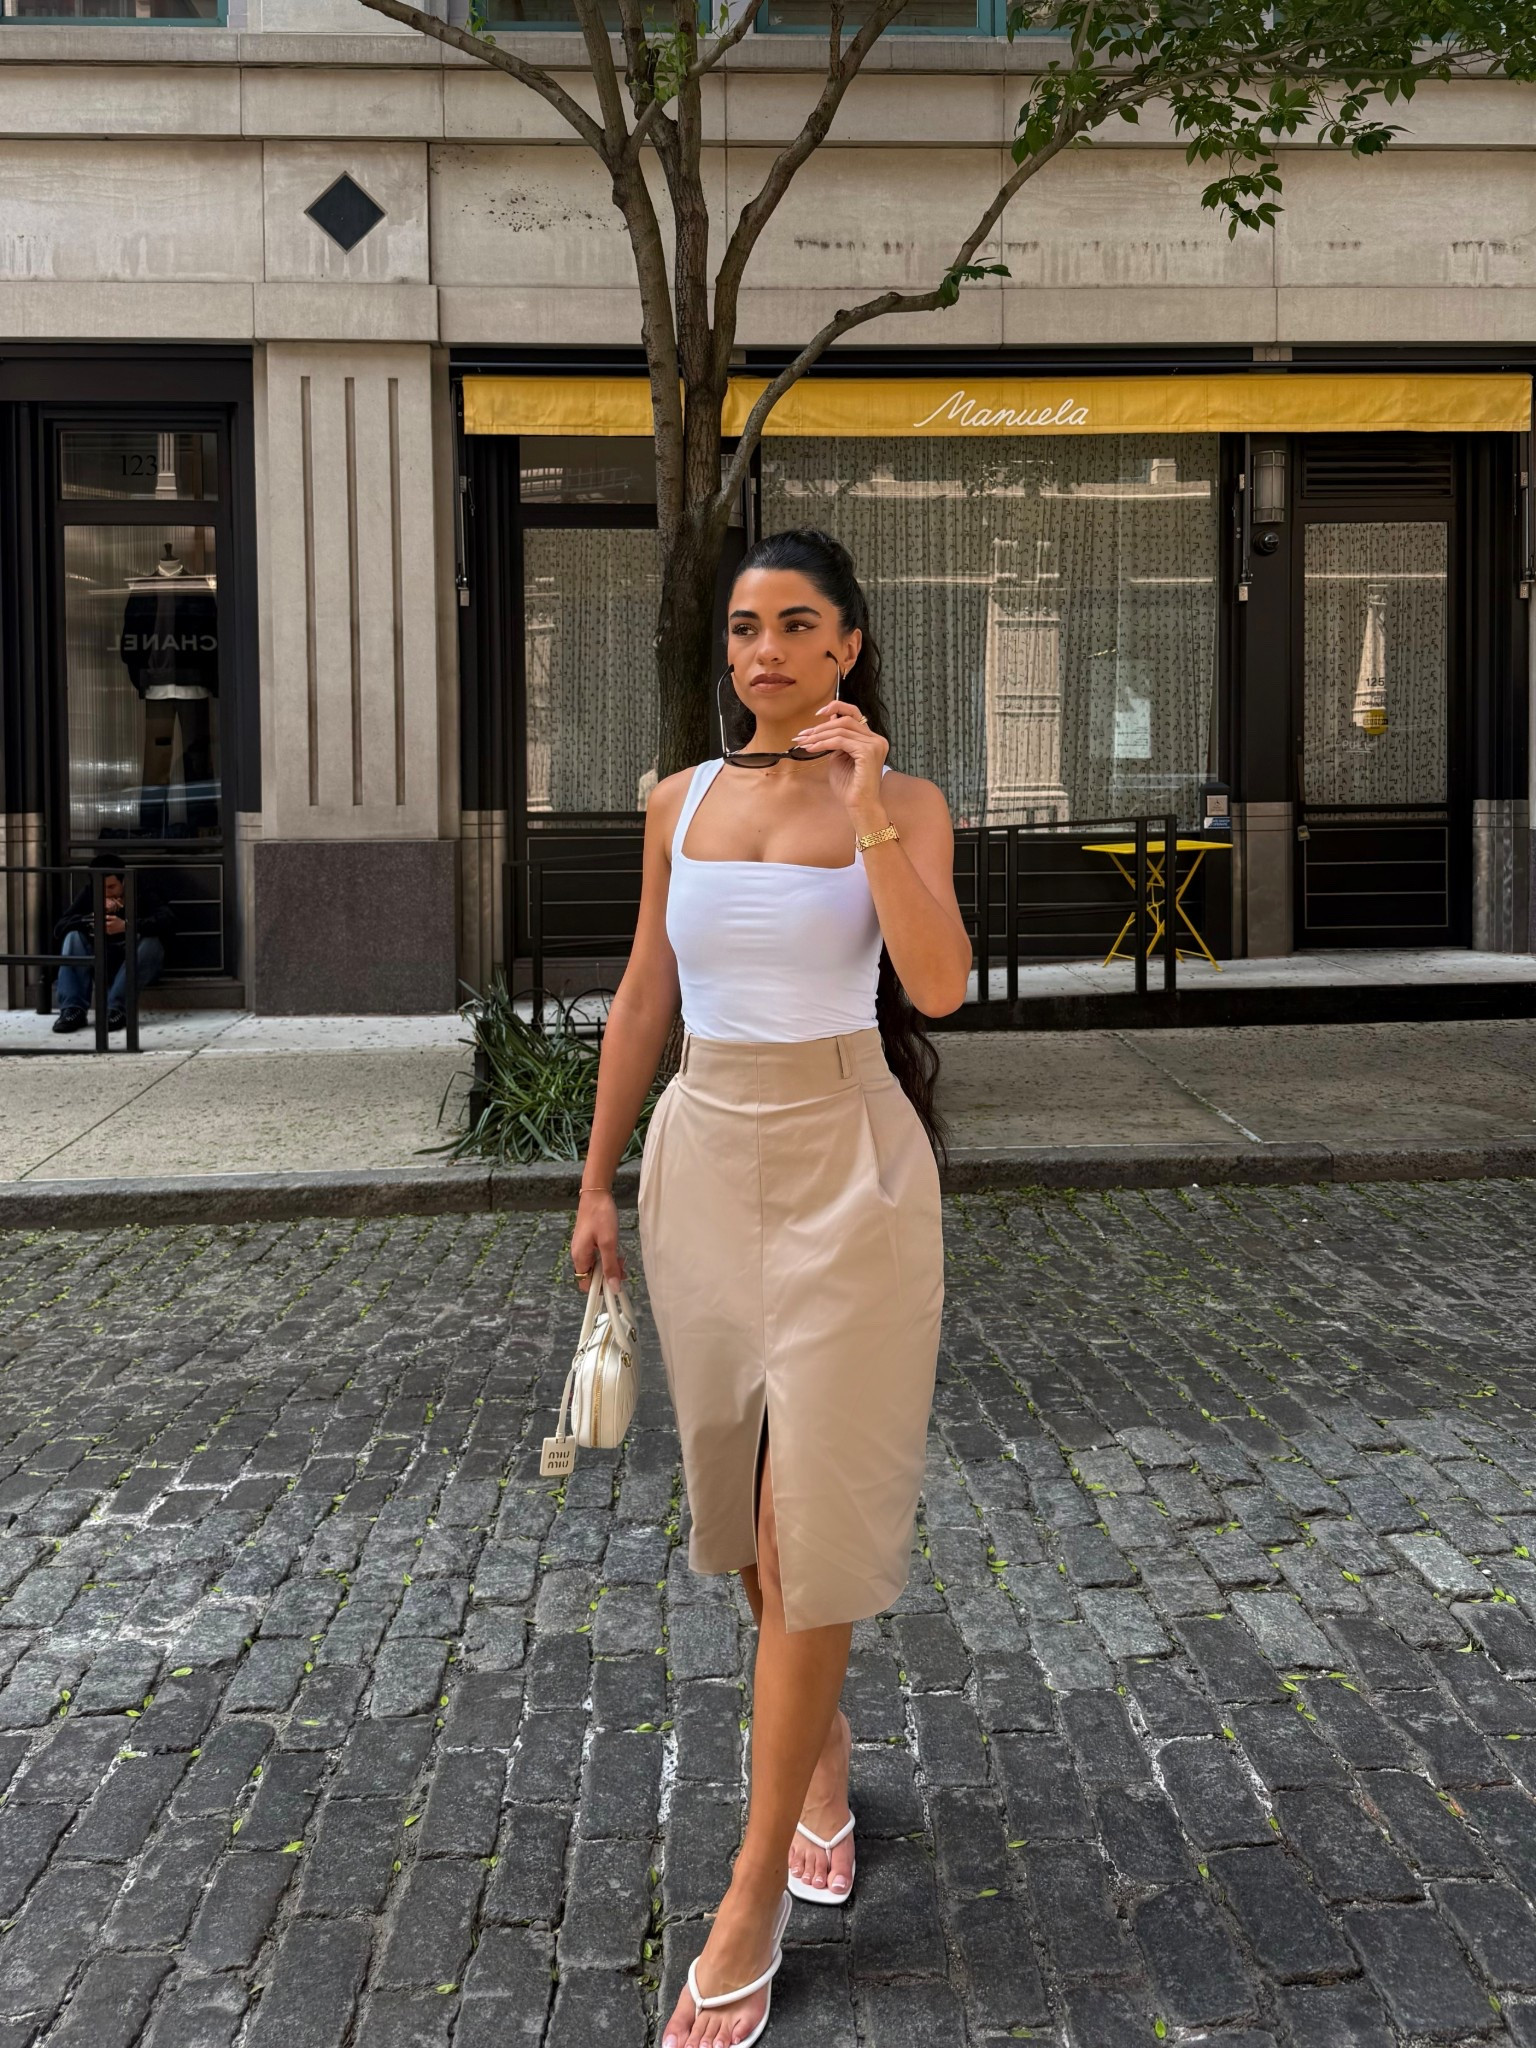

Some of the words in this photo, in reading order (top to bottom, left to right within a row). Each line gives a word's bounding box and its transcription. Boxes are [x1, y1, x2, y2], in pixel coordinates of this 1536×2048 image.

[913, 390, 1089, 428] Manuela
[120, 454, 158, 476] 123
[1366, 677, 1385, 687] 125
